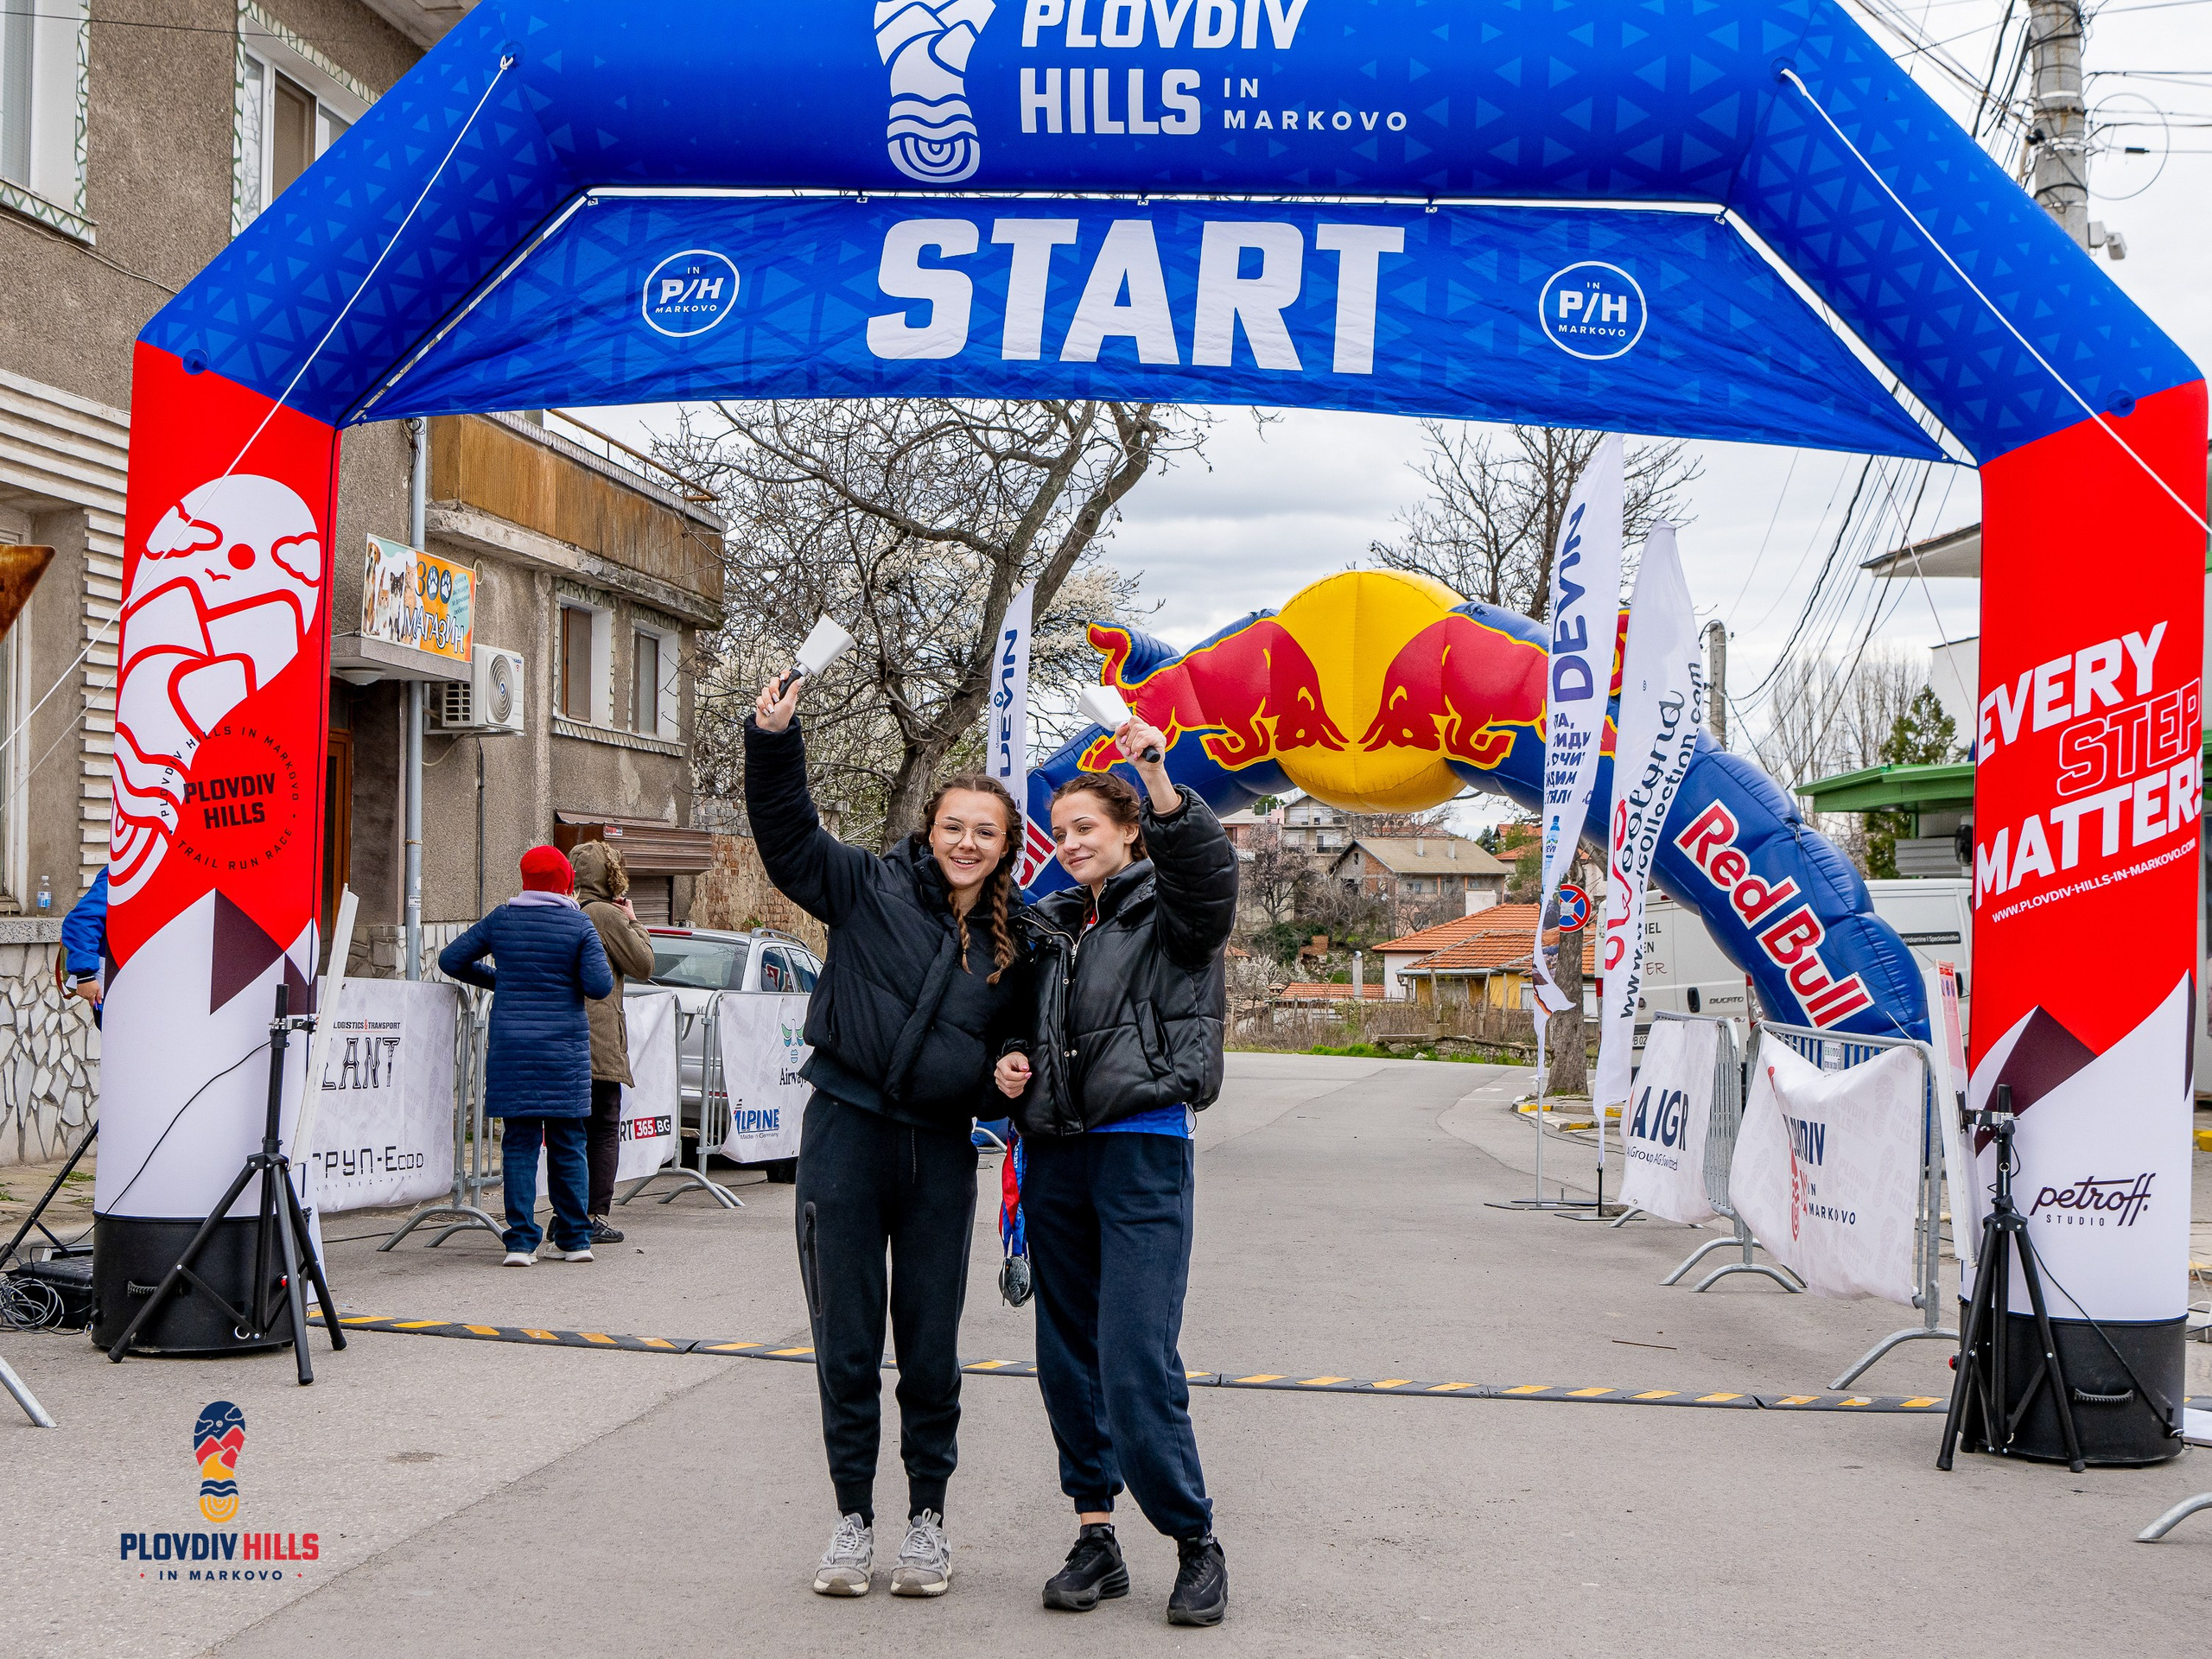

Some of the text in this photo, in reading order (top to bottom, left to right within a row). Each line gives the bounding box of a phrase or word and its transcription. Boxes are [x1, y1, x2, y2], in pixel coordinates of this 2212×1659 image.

[1020, 0, 1306, 49] PLOVDIV
[1020, 68, 1201, 135] HILLS
[1224, 79, 1259, 98] IN
[1224, 110, 1408, 131] MARKOVO
[655, 305, 718, 314] MARKOVO
[659, 277, 725, 305] P/H
[866, 218, 1406, 374] START
[1559, 289, 1627, 324] P/H
[1558, 325, 1626, 337] MARKOVO
[1552, 502, 1593, 702] DEVIN
[404, 606, 464, 653] МАГАЗИН
[1000, 628, 1019, 777] DEVIN
[1977, 620, 2169, 767] EVERY
[2056, 677, 2201, 796] STEP
[160, 726, 299, 817] PLOVDIV HILLS IN MARKOVO
[183, 772, 276, 804] PLOVDIV
[203, 802, 266, 829] HILLS
[1975, 746, 2203, 910] MATTERS
[177, 828, 292, 870] TRAIL RUN RACE
[1992, 837, 2196, 924] WWW.PLOVDIV-HILLS-IN-MARKOVO.COM
[1679, 804, 1869, 1028] Red Bull
[1643, 962, 1668, 976] ER
[321, 1037, 400, 1090] LANT
[779, 1067, 806, 1088] Airway
[620, 1118, 671, 1142] RT365.BG
[1808, 1183, 1816, 1196] IN
[2029, 1173, 2156, 1227] petroff.
[1808, 1202, 1856, 1225] MARKOVO
[2046, 1214, 2105, 1227] STUDIO
